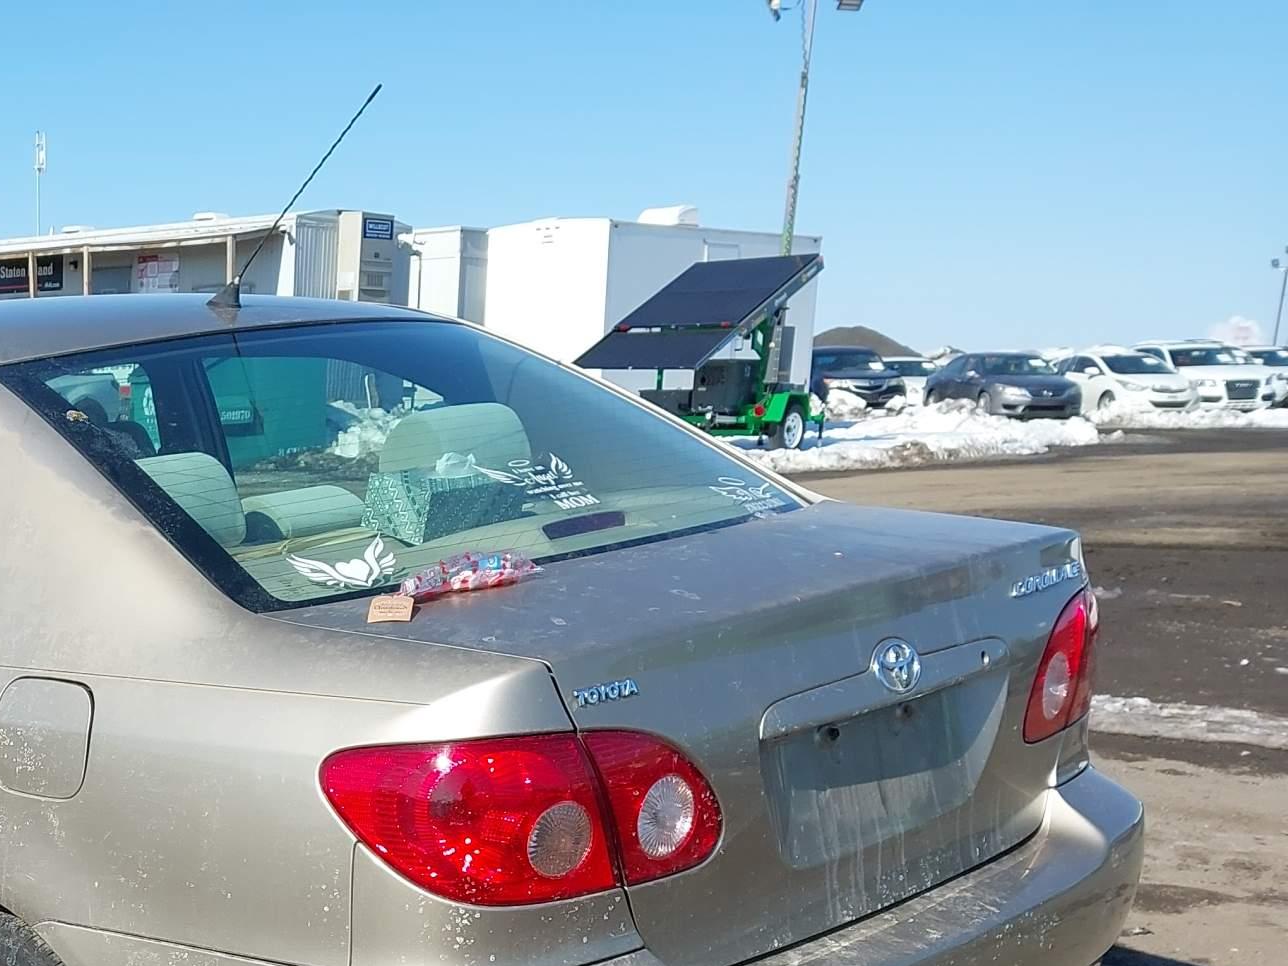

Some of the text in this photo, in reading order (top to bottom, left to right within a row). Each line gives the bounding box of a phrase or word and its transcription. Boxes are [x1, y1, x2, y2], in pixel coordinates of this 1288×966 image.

[0, 265, 26, 279] Staten
[553, 494, 601, 510] MOM
[573, 679, 638, 706] TOYOTA
